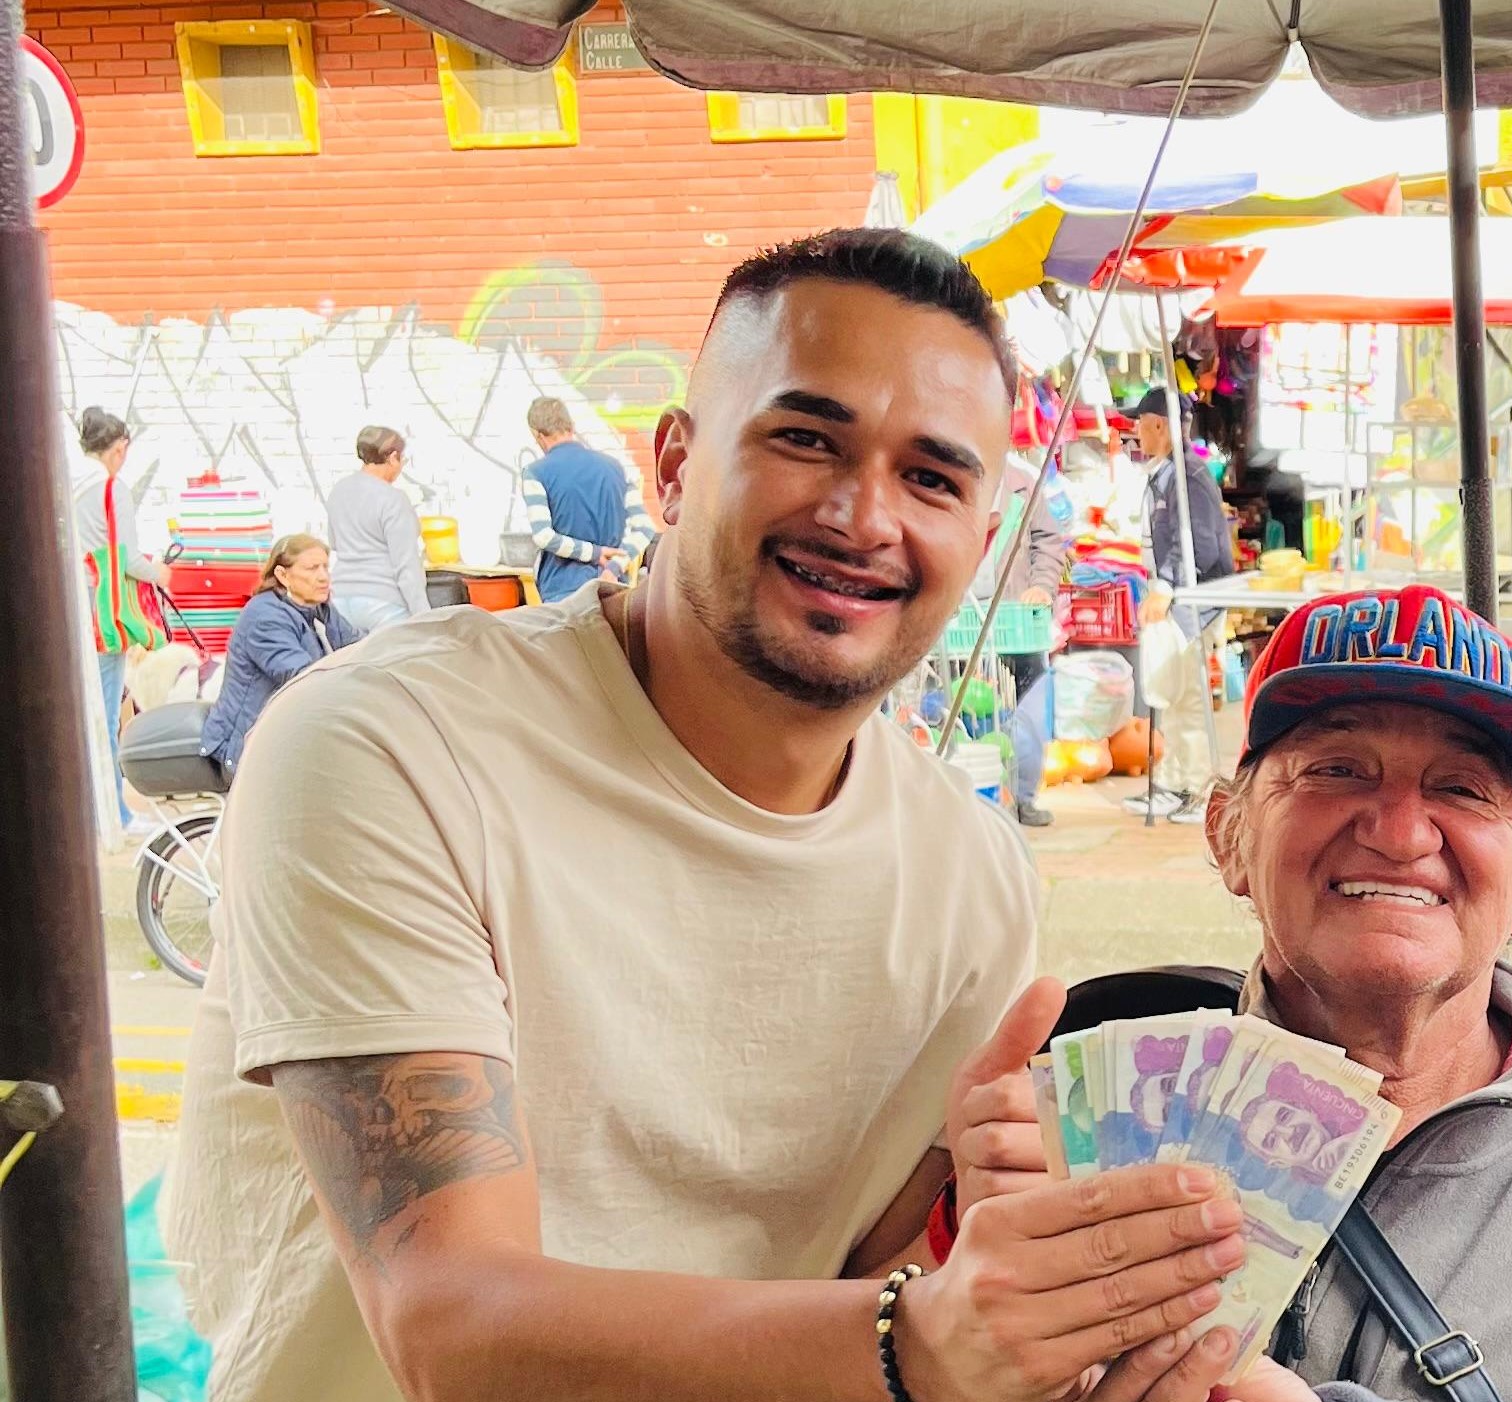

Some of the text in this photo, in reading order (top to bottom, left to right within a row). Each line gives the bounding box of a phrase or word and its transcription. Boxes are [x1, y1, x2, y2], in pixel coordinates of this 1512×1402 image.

[584, 27, 636, 50] CARRERA
[586, 51, 623, 70] CALLE
[1303, 1079, 1364, 1120] CINCUENTA
